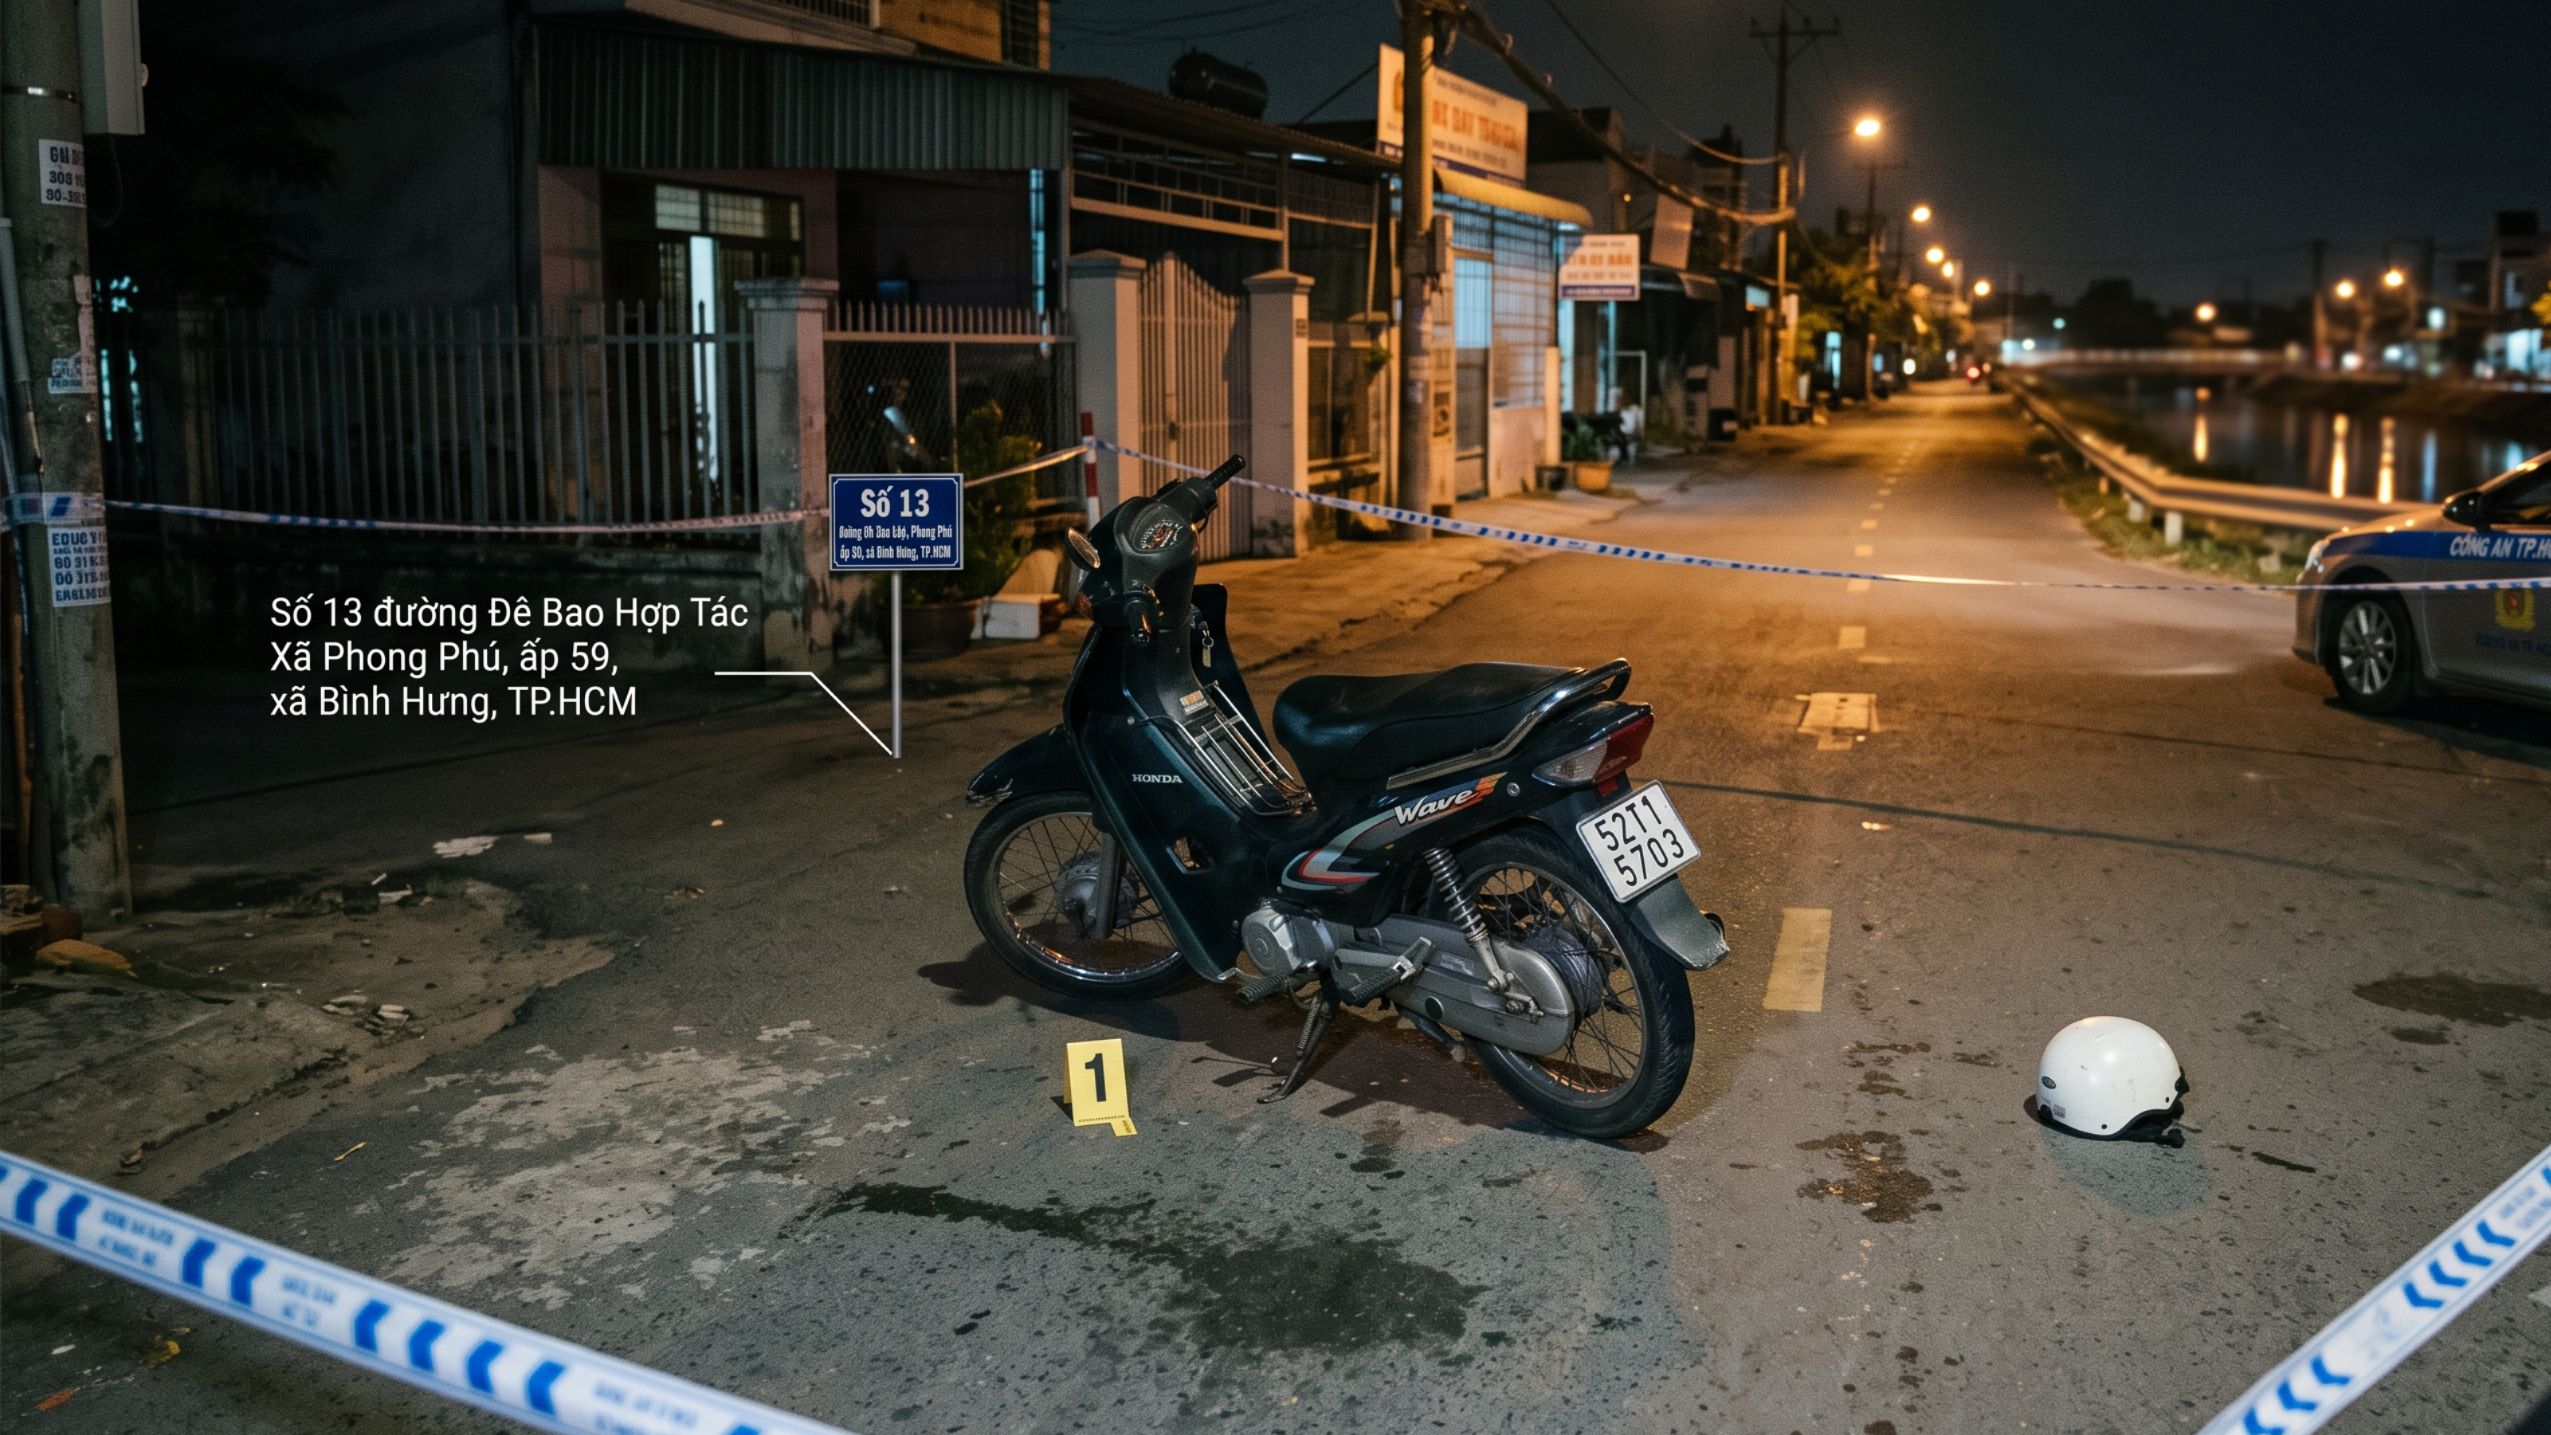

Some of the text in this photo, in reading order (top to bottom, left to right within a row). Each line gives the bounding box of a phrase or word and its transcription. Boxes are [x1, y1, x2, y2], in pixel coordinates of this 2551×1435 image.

[861, 485, 929, 517] Số 13
[2490, 537, 2515, 558] AN
[1132, 774, 1183, 784] HONDA
[1394, 789, 1477, 825] Wave
[1594, 795, 1662, 851] 52T1
[1613, 828, 1684, 886] 5703
[1084, 1053, 1107, 1102] 1
